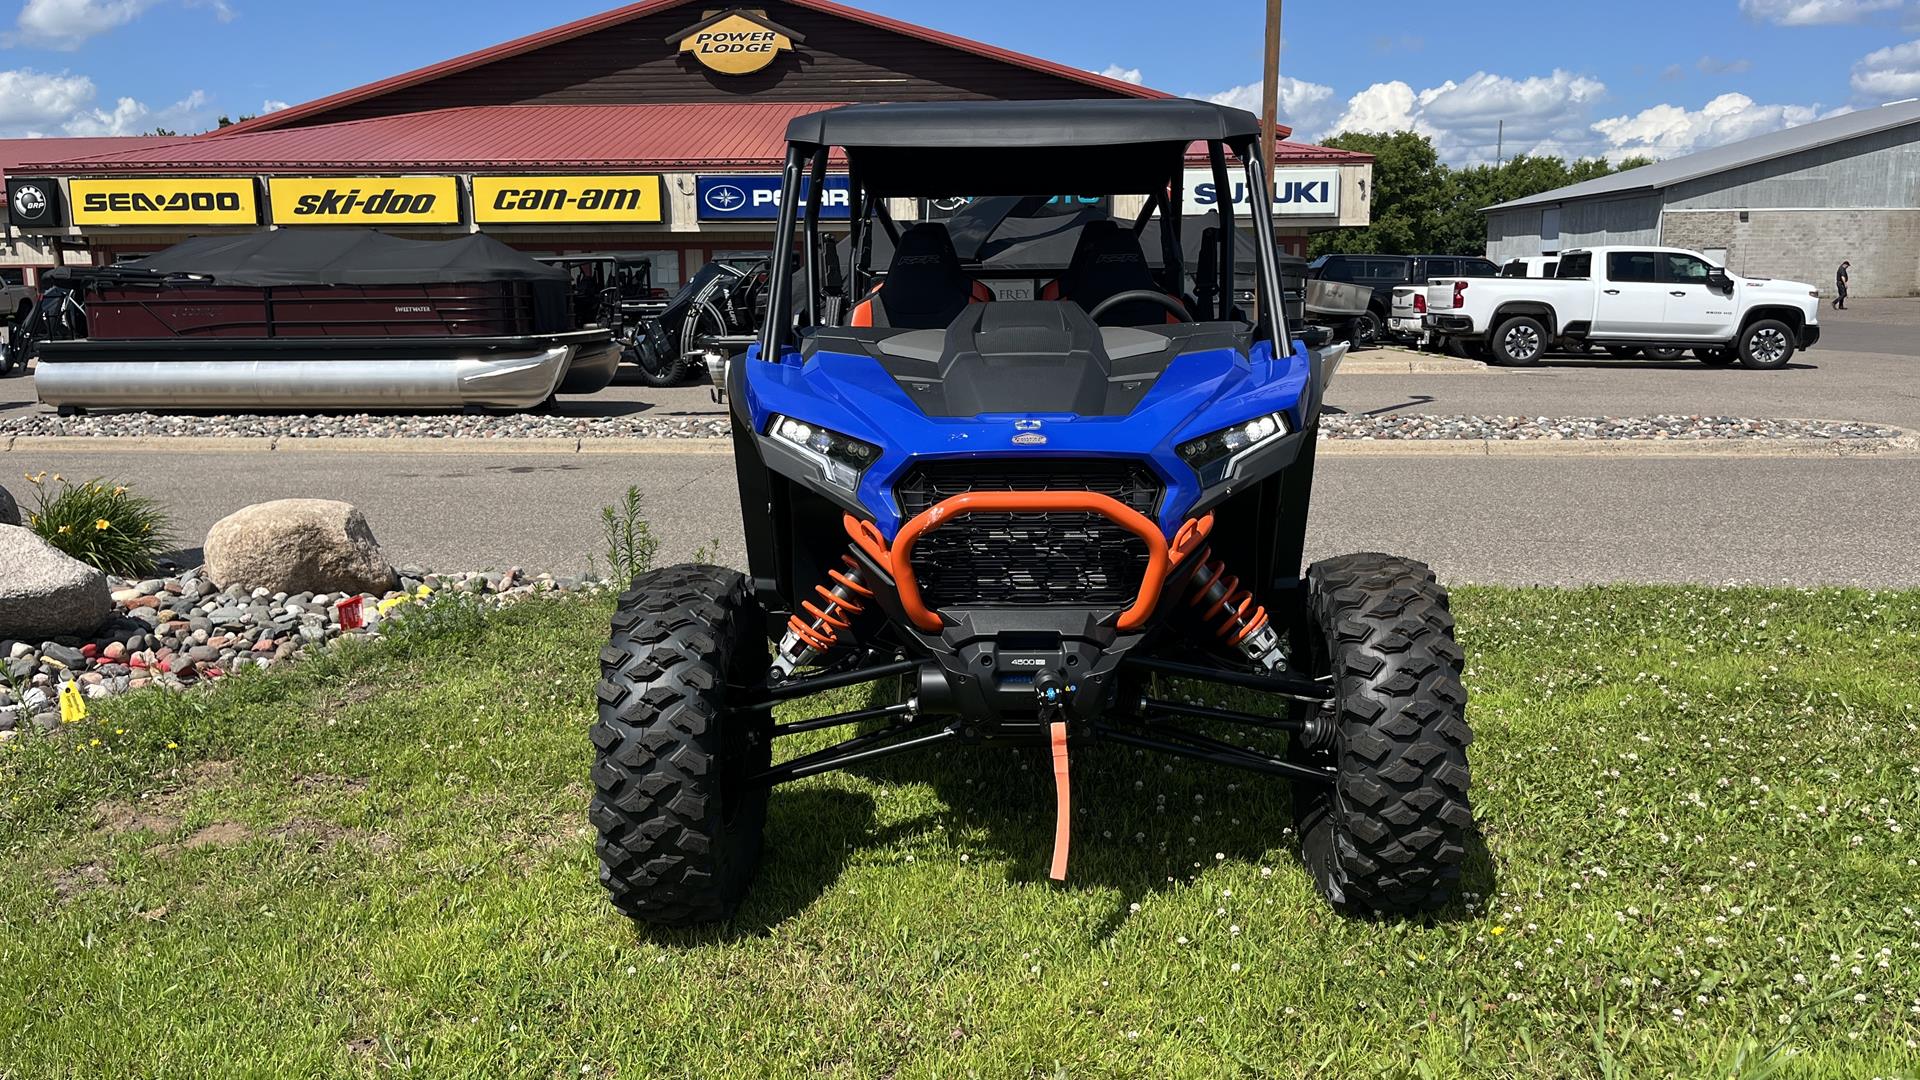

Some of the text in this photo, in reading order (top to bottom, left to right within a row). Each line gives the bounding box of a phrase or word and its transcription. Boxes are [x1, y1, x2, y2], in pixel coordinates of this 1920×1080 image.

[696, 32, 776, 44] POWER
[700, 43, 773, 53] LODGE
[293, 189, 437, 215] ski-doo
[493, 188, 642, 210] can-am
[1194, 181, 1329, 204] SUUKI
